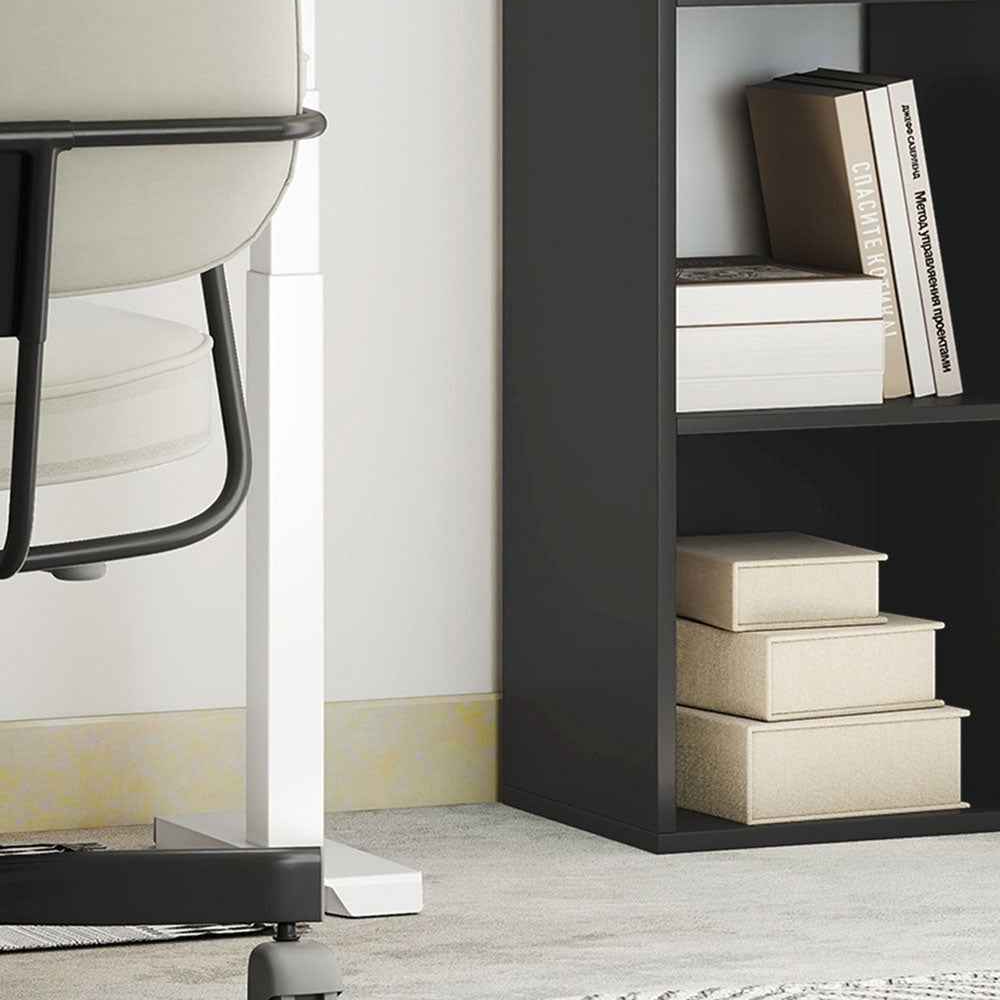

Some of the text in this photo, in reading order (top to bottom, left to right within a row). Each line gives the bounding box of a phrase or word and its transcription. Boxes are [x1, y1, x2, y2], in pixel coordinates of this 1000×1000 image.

[851, 161, 883, 249] СПАСИТЕ
[914, 190, 929, 232] Метод
[932, 306, 952, 374] проектами
